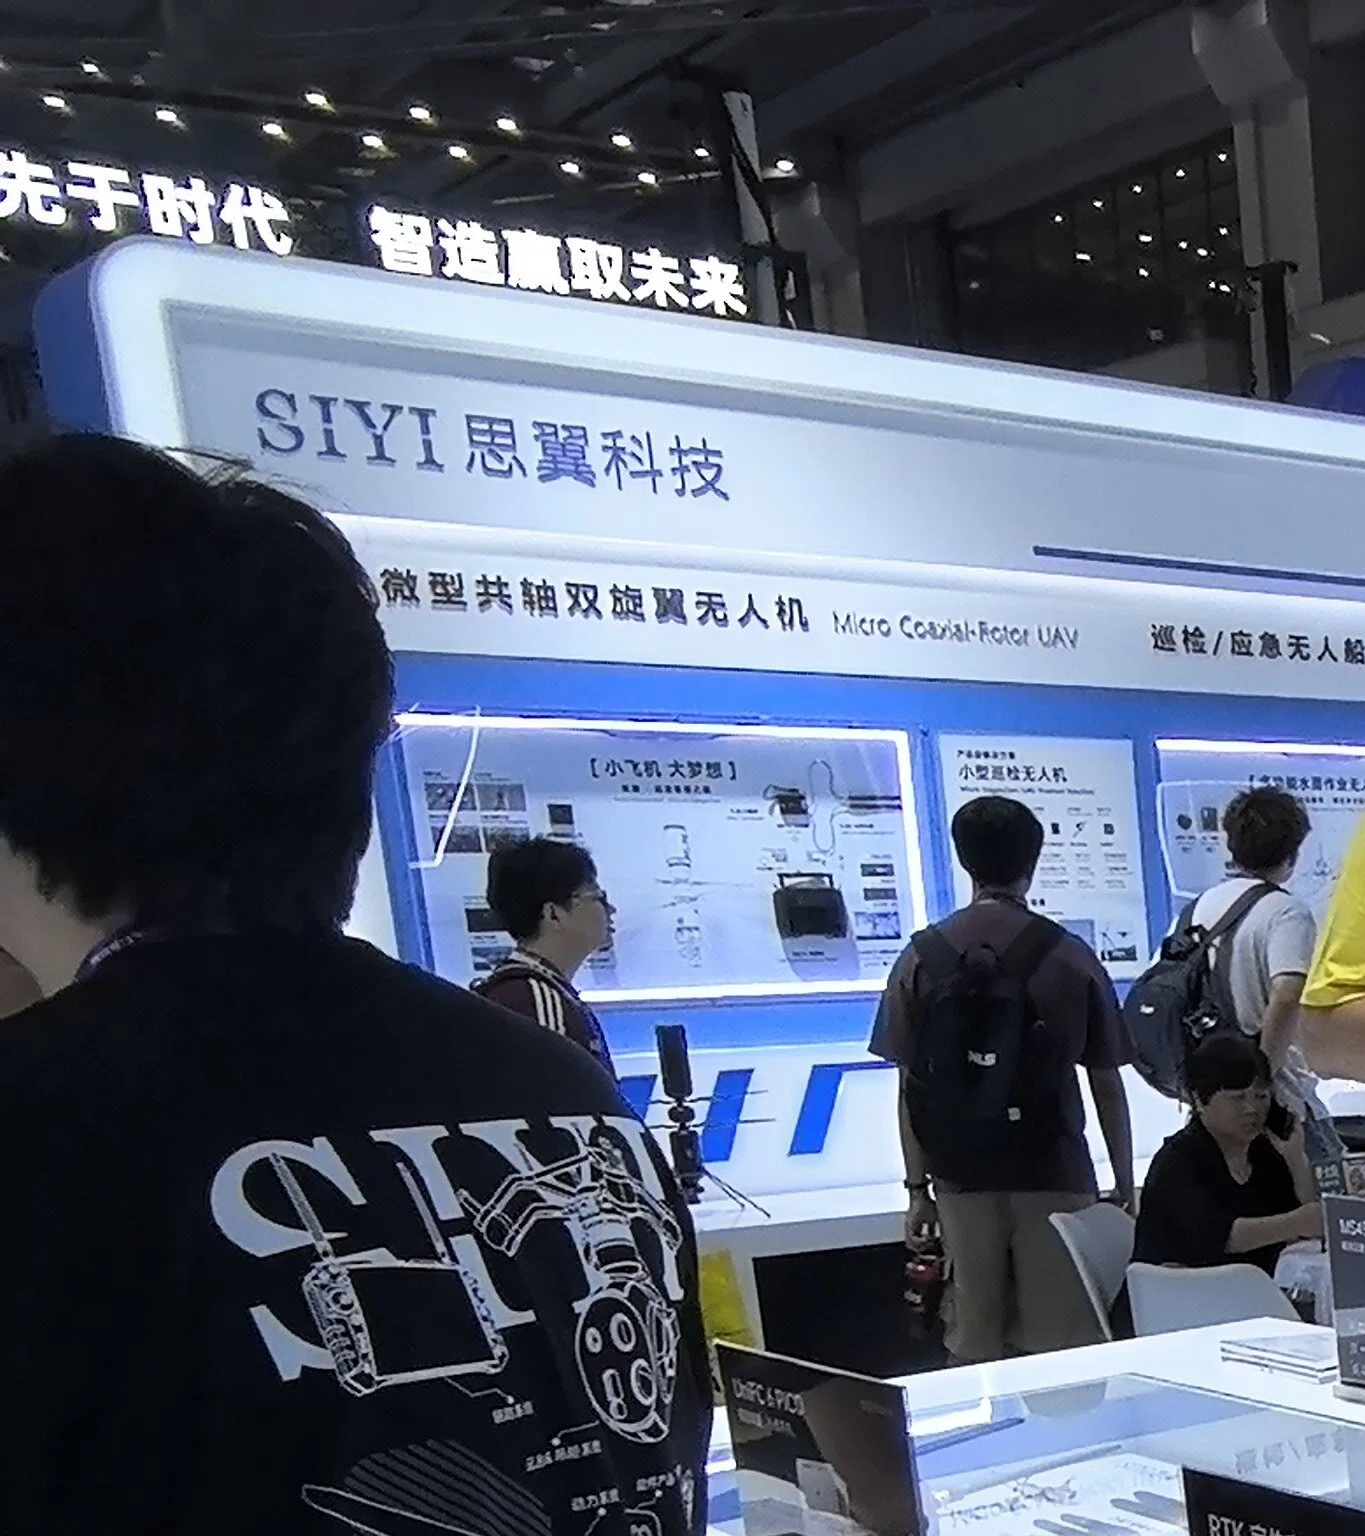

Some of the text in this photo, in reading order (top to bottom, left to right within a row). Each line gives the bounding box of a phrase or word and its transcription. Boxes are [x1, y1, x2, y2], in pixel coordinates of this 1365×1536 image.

[0, 150, 293, 257] 先于时代
[368, 204, 748, 317] 智造赢取未来
[254, 388, 731, 503] SIYI 思翼科技
[379, 567, 809, 635] 微型共轴双旋翼无人机
[833, 610, 892, 639] Micro
[1036, 624, 1079, 650] UAV
